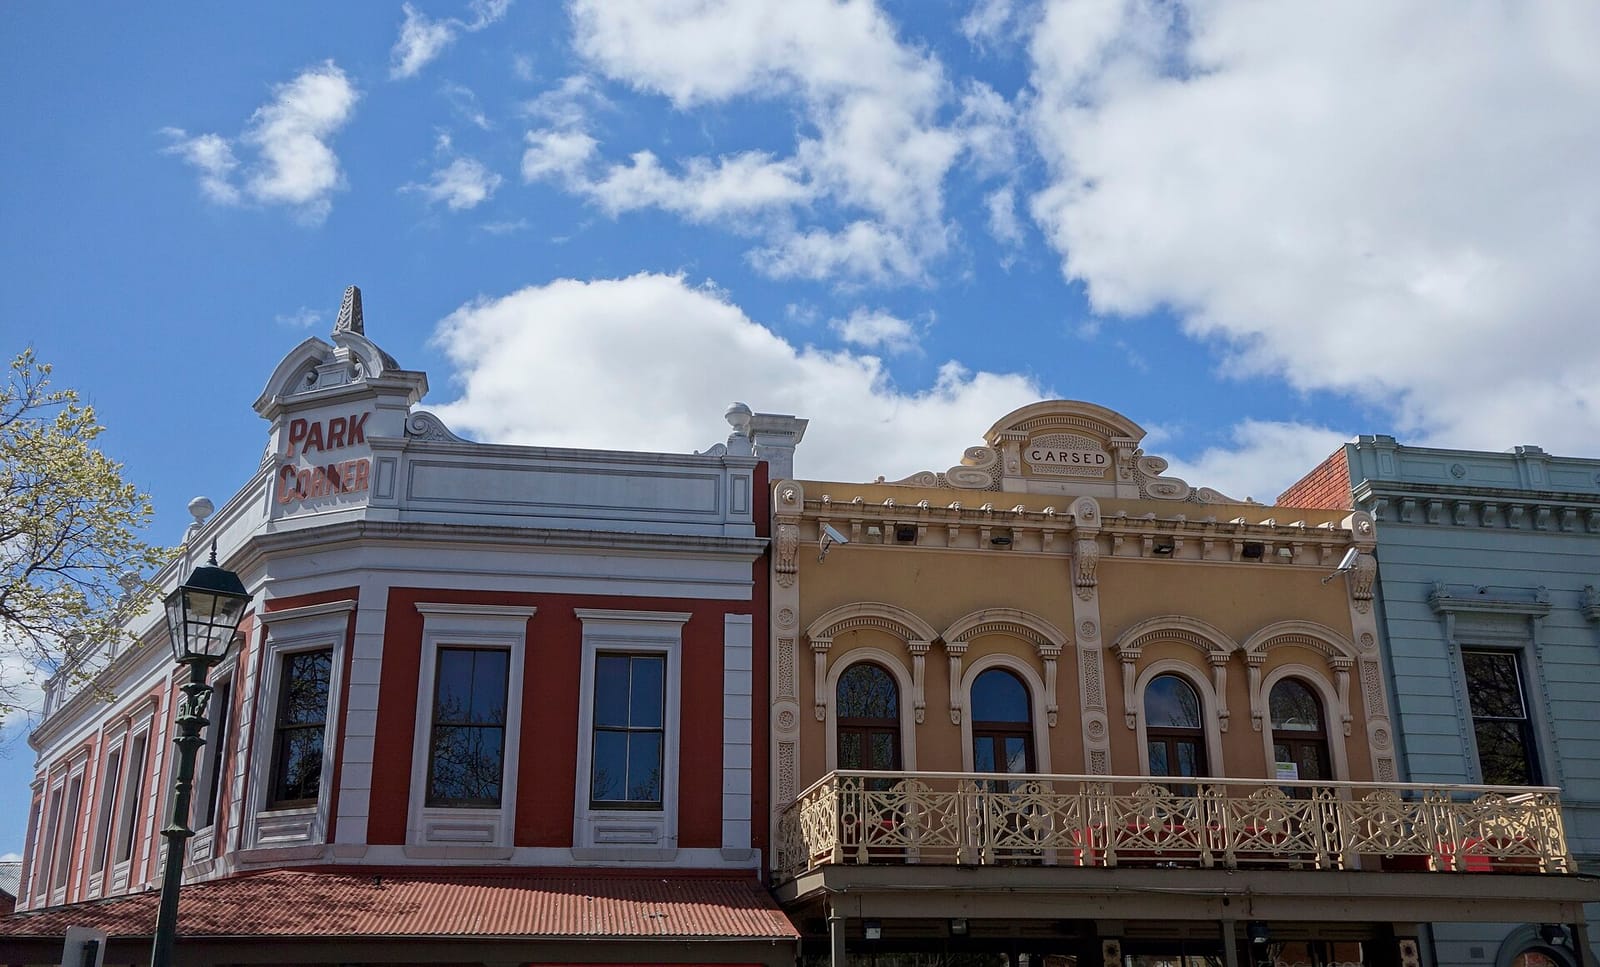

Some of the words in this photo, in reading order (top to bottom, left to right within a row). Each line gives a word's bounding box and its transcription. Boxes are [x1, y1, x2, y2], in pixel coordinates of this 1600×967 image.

[287, 413, 369, 456] PARK
[1032, 451, 1104, 464] CARSED
[278, 459, 370, 504] CORNER
